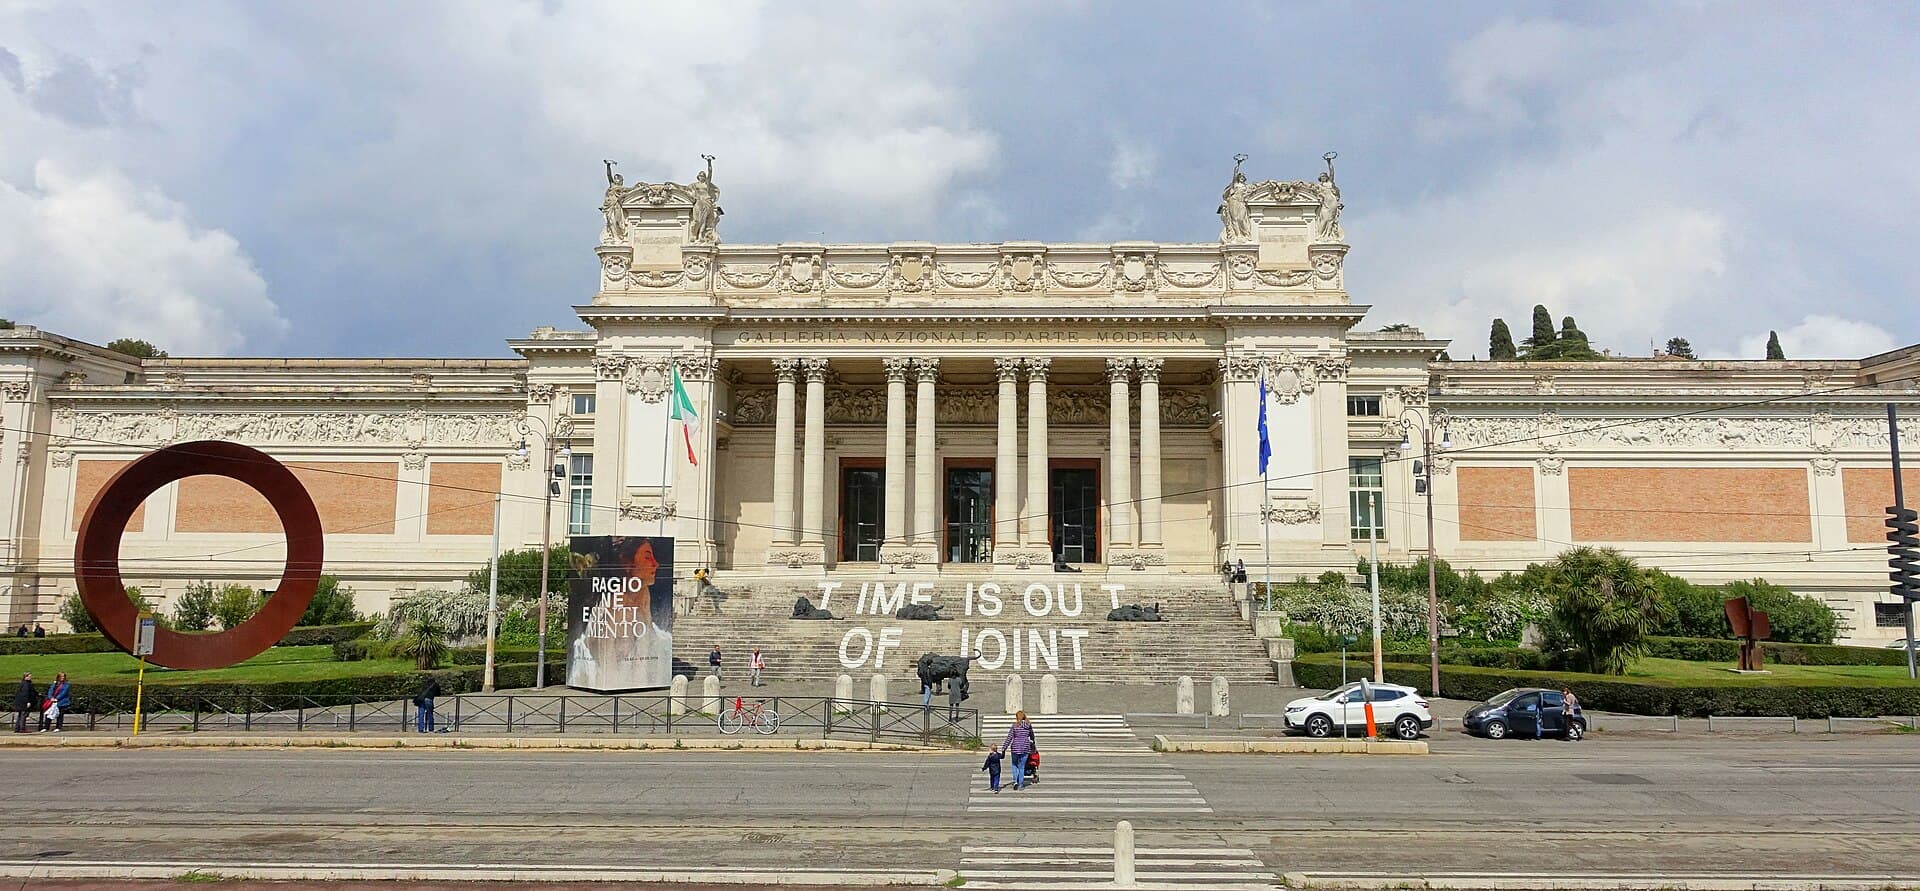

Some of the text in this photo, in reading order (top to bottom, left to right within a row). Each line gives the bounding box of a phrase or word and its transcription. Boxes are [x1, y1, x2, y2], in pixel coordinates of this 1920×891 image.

[738, 330, 1199, 344] GALLERIA NAZIONALE D'ARTE MODERNA
[592, 576, 642, 593] RAGIO
[602, 592, 624, 608] NE
[964, 582, 1003, 617] IS
[587, 621, 647, 639] MENTO
[838, 627, 903, 669] OF
